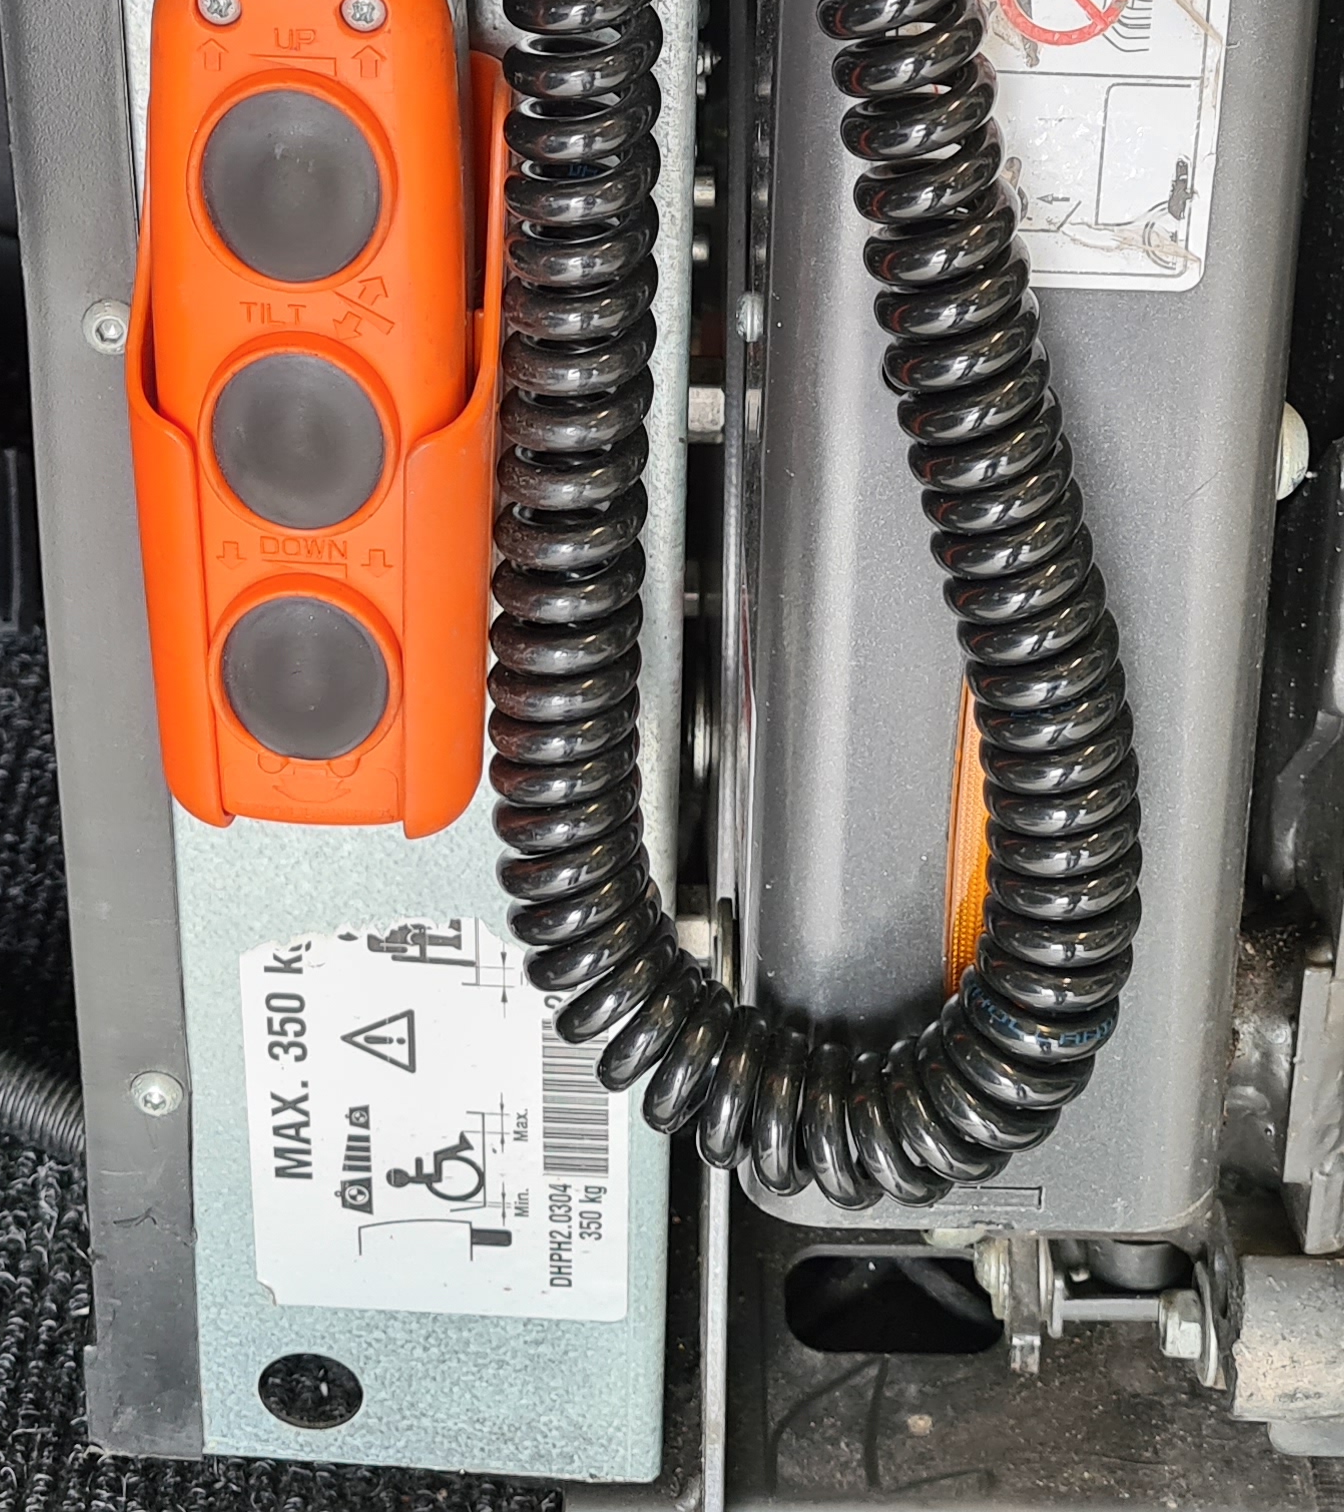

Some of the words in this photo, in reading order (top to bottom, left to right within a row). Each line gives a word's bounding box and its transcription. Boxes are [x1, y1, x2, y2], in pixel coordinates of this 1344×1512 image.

[273, 27, 317, 52] UP
[239, 301, 307, 326] TILT
[259, 535, 348, 561] DOWN
[264, 991, 308, 1063] 350
[269, 1079, 313, 1180] MAX.
[513, 1108, 529, 1143] Max.
[514, 1187, 530, 1218] Min.
[579, 1185, 607, 1205] kg
[549, 1183, 573, 1288] DHPH2.0304
[579, 1209, 603, 1241] 350
